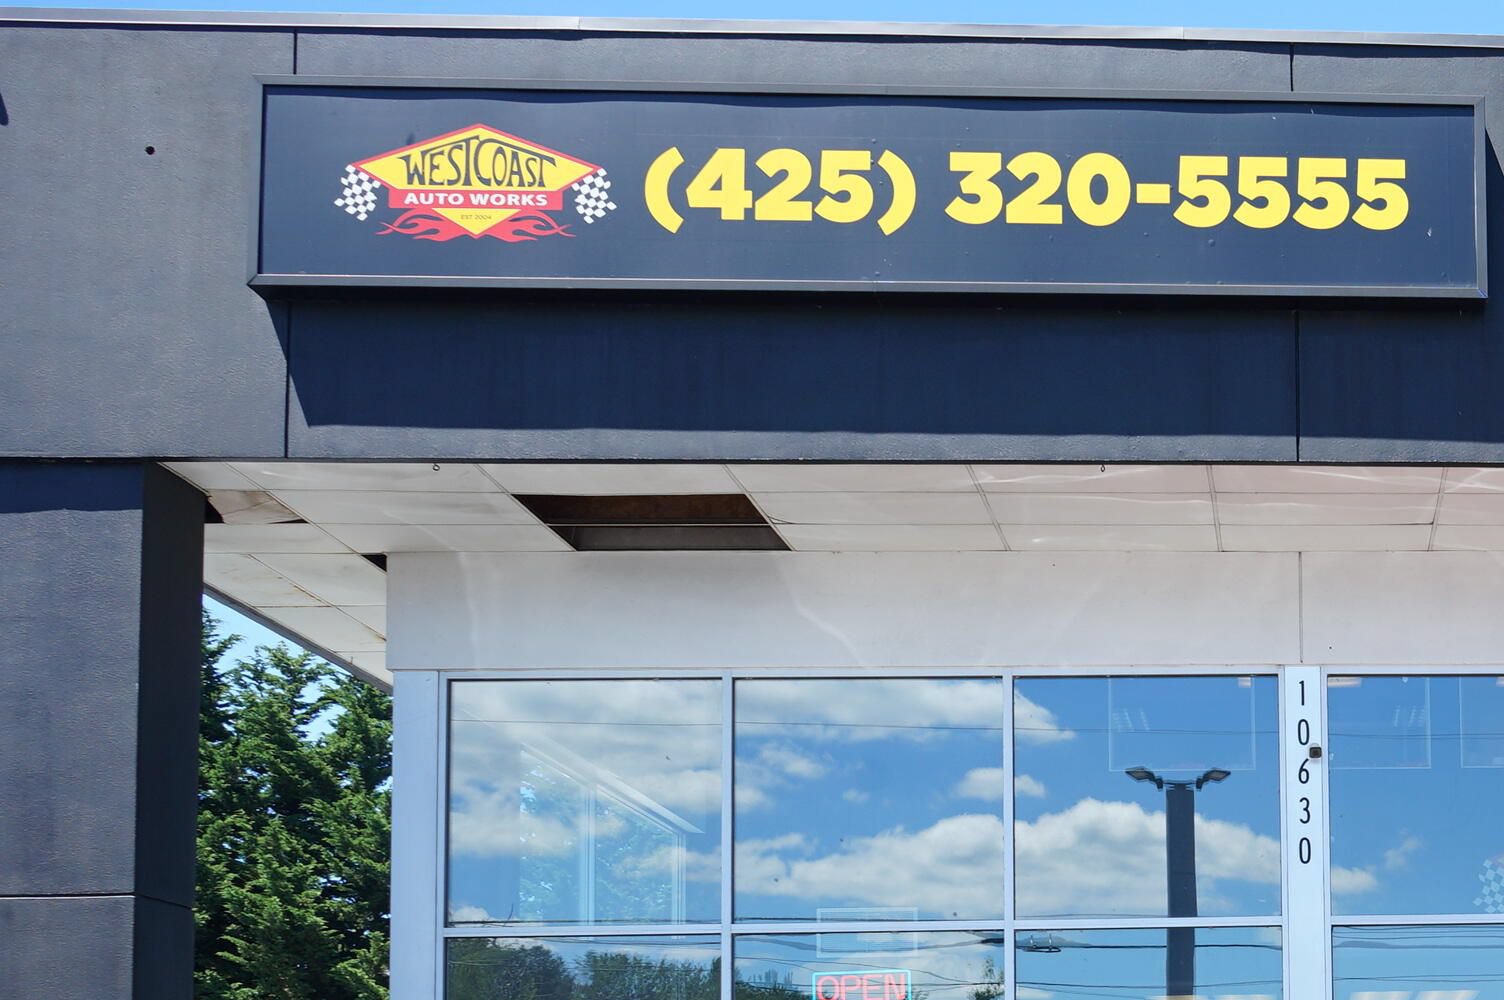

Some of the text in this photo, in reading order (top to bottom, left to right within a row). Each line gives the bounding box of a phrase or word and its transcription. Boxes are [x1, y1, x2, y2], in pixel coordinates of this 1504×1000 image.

[404, 193, 548, 206] AUTO WORKS
[644, 146, 1409, 235] (425) 320-5555
[1298, 680, 1311, 864] 10630
